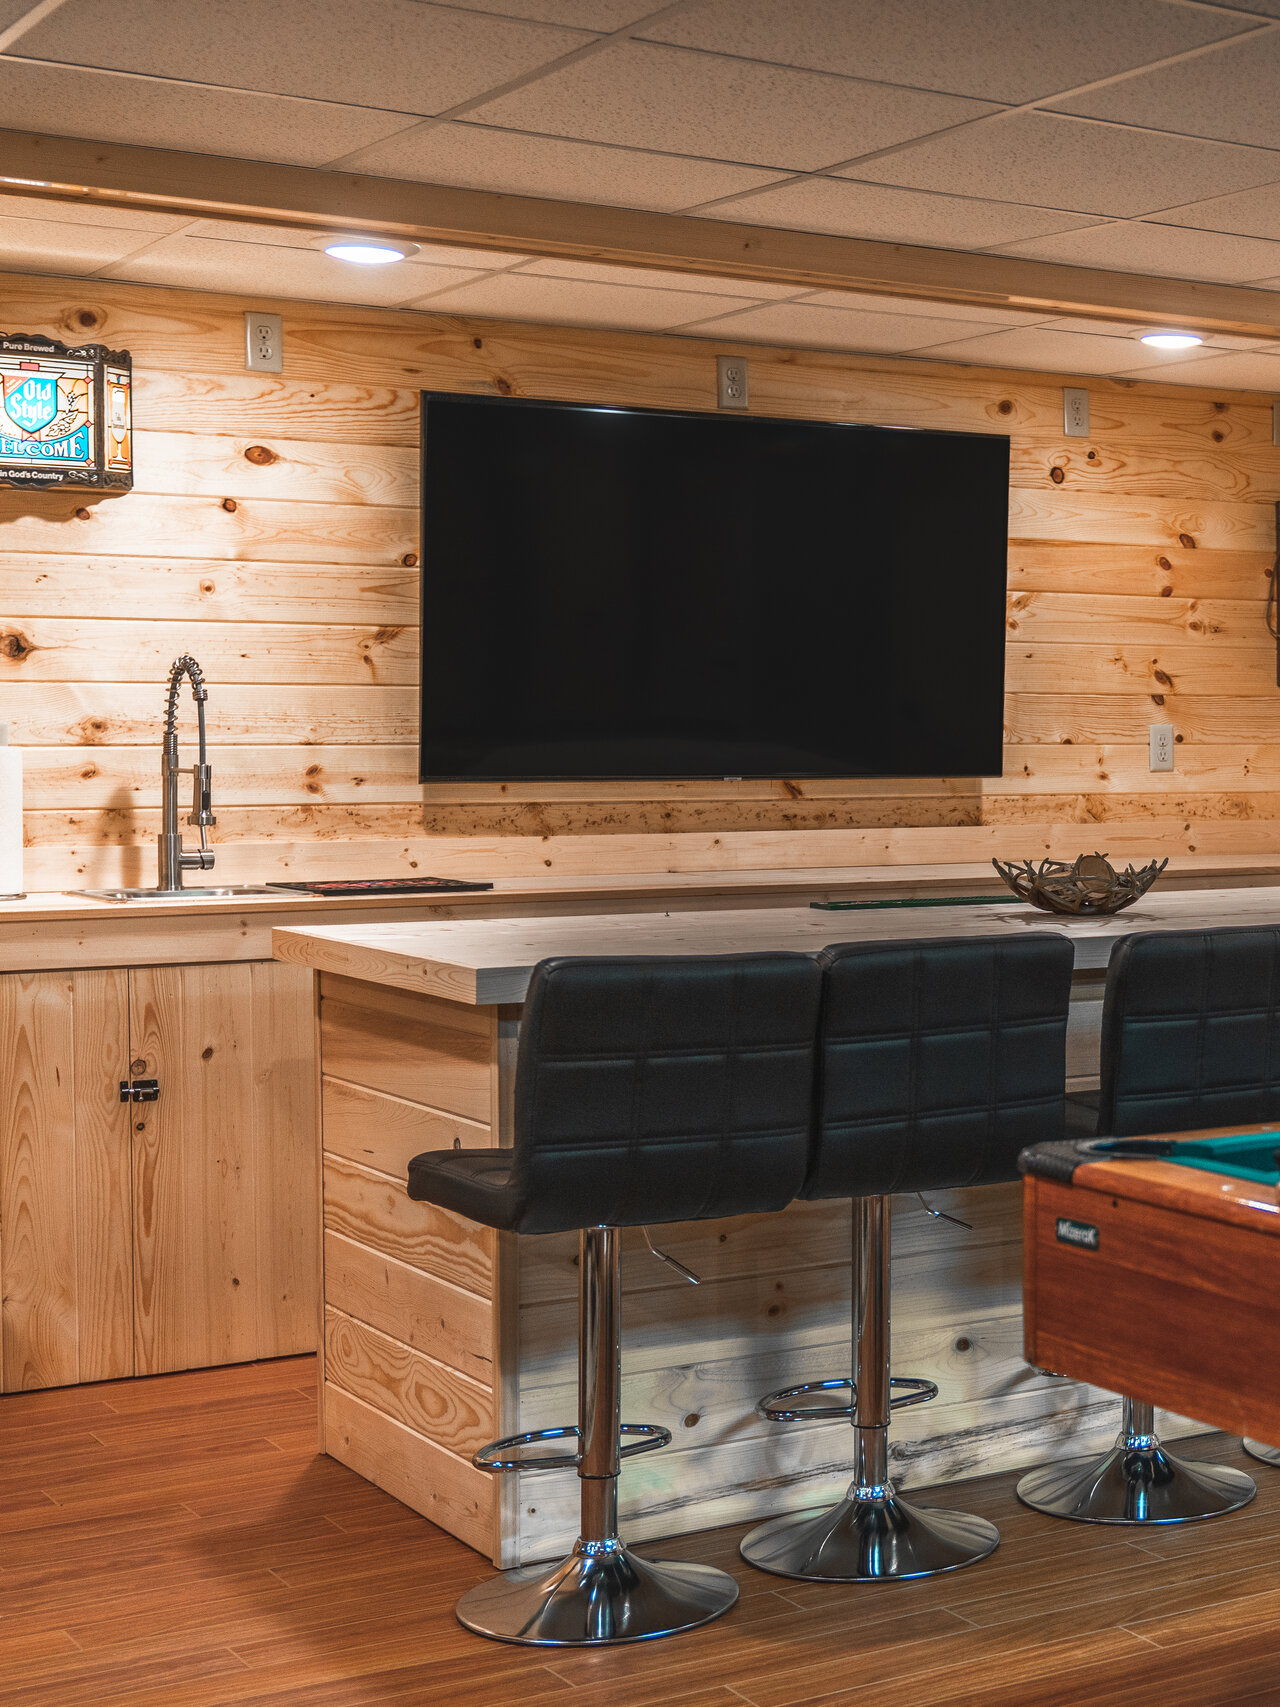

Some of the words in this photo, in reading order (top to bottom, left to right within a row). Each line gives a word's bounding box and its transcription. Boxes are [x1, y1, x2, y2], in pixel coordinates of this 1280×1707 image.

[3, 341, 23, 350] Pure
[24, 343, 55, 353] Brewed
[23, 379, 52, 401] Old
[10, 392, 53, 428] Style
[0, 431, 85, 459] ELCOME
[8, 470, 31, 479] God's
[31, 471, 64, 482] Country
